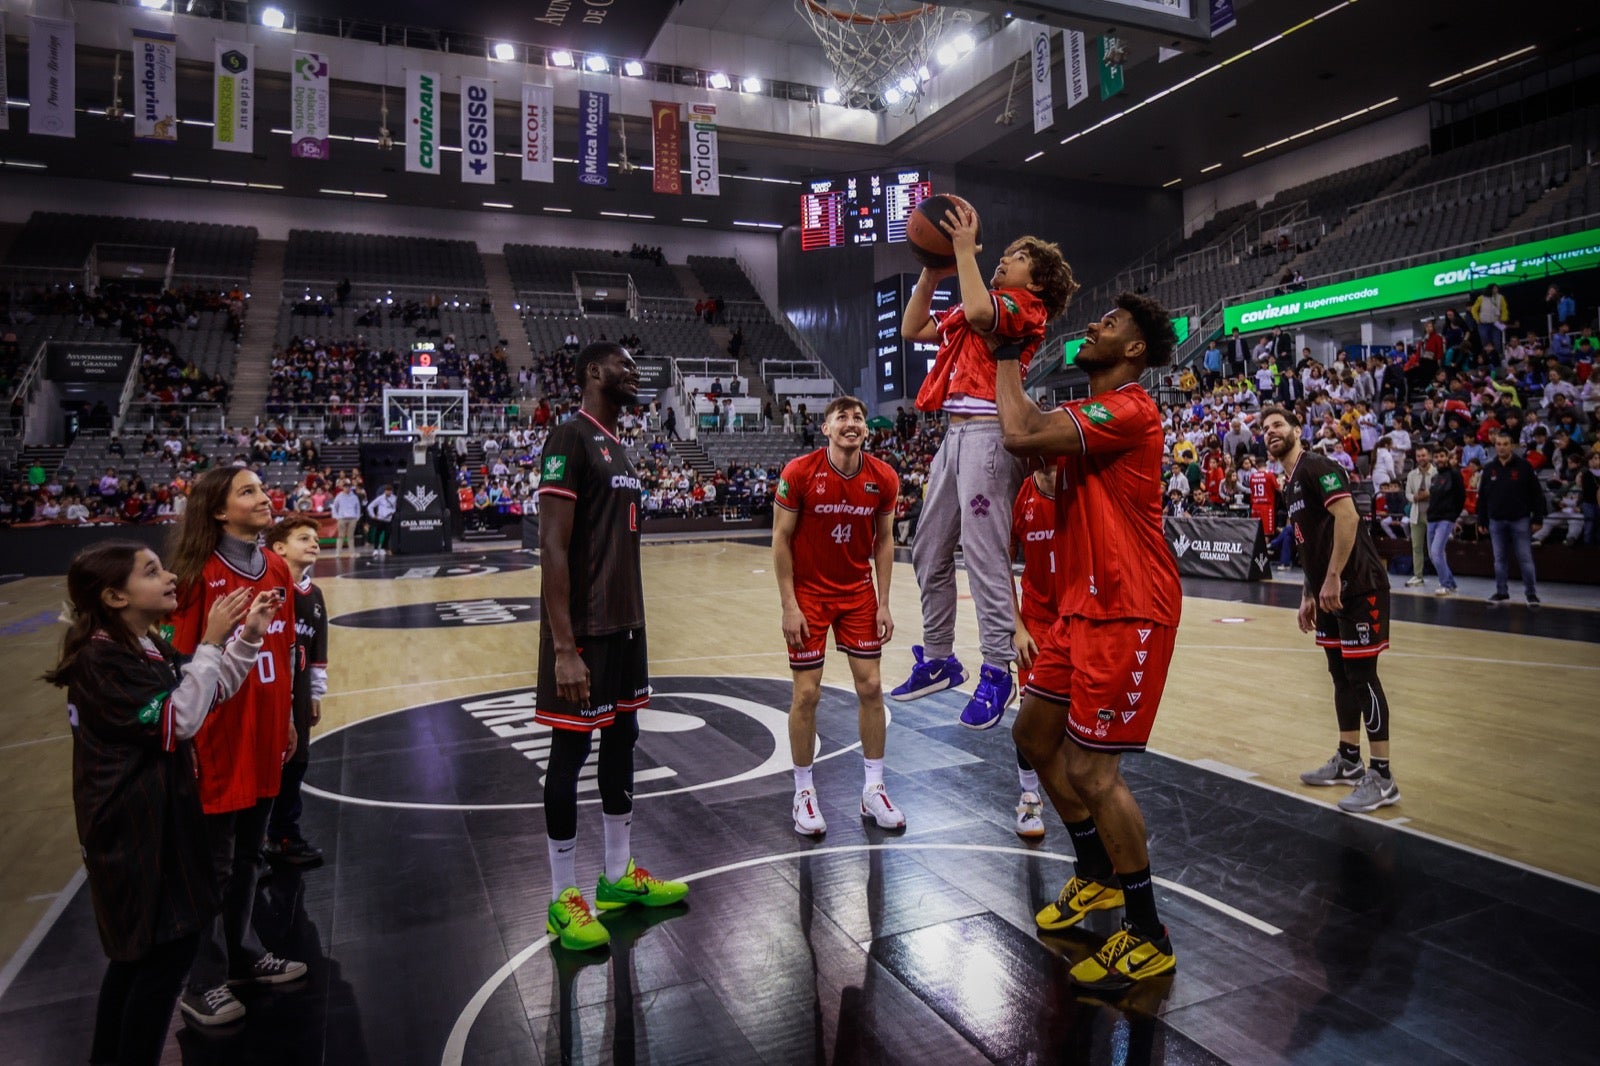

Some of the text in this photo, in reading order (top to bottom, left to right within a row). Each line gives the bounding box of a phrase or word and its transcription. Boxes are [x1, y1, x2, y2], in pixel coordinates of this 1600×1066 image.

[142, 42, 159, 121] aeroprint
[240, 78, 250, 130] cidesur
[294, 86, 305, 129] Deportes
[306, 87, 317, 136] Palacio de
[412, 74, 433, 169] COVIRAN
[468, 86, 487, 155] asisa
[527, 104, 539, 163] RICOH
[585, 92, 598, 174] Mica Motor
[693, 131, 711, 181] orion
[670, 133, 679, 190] ANTONIO
[859, 218, 874, 229] 1:30
[1241, 287, 1379, 324] COVIRAN supermercados
[419, 353, 432, 367] 9
[814, 499, 874, 516] COVIRAN
[1253, 484, 1264, 497] 19
[831, 523, 852, 544] 44
[1191, 540, 1243, 554] CAJA RURAL
[1199, 552, 1230, 561] GRANADA
